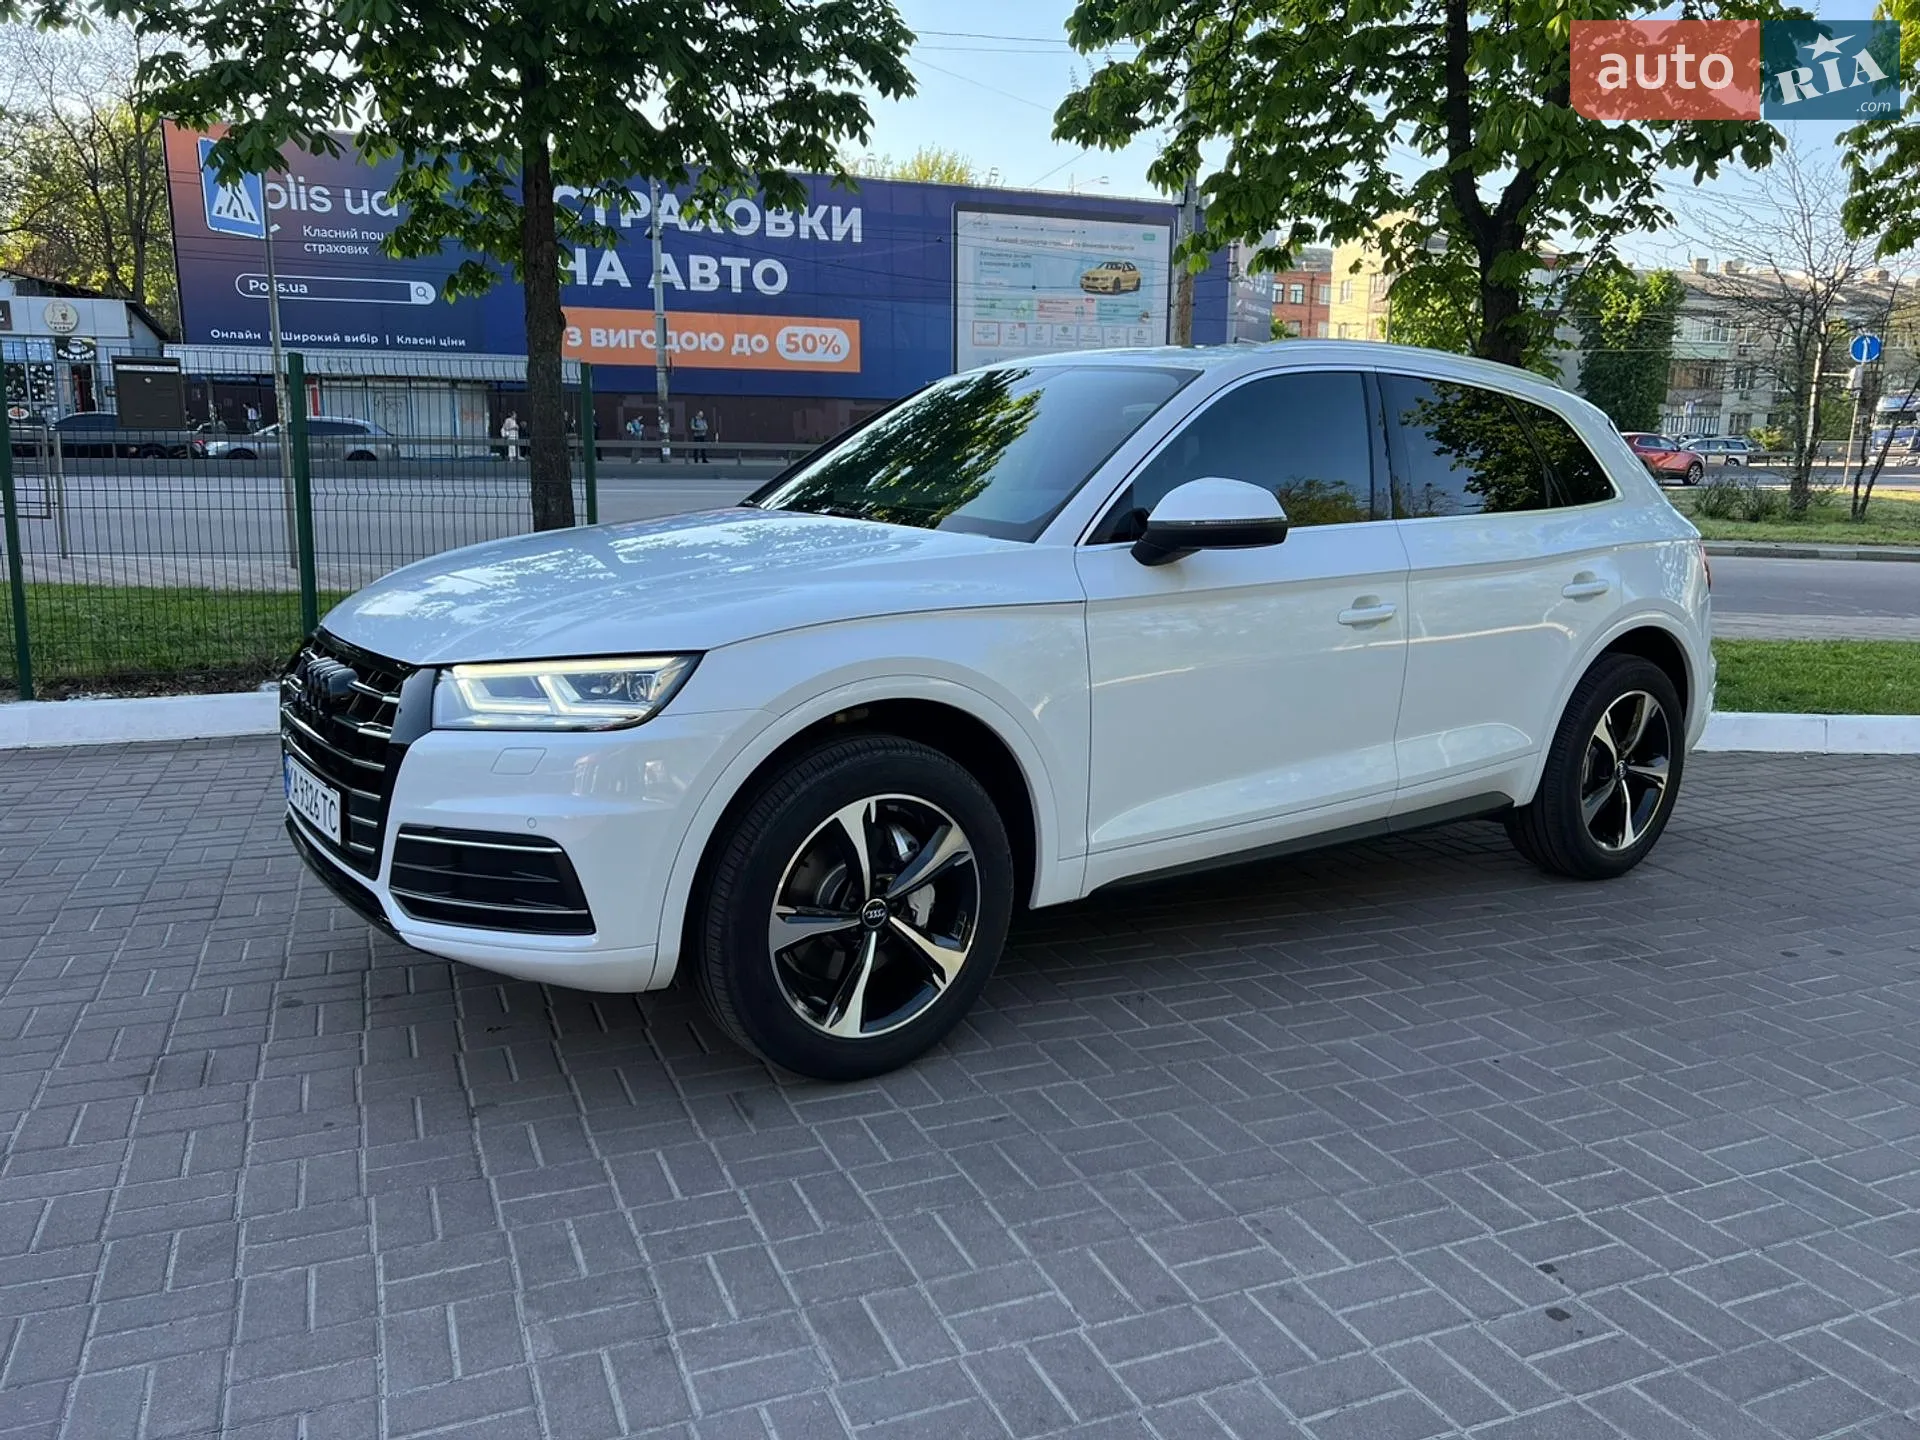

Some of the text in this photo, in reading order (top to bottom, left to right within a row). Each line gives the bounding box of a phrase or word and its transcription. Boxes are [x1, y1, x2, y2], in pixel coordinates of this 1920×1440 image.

[266, 173, 332, 213] olis
[302, 225, 358, 240] Класний
[303, 242, 370, 255] страхових
[648, 253, 789, 296] АВТО
[248, 279, 308, 294] Pois.ua
[210, 328, 466, 347] Онлайн Широкий вибір Класні ціни
[590, 327, 725, 353] вигодою
[731, 332, 769, 356] до
[785, 331, 841, 356] 50%
